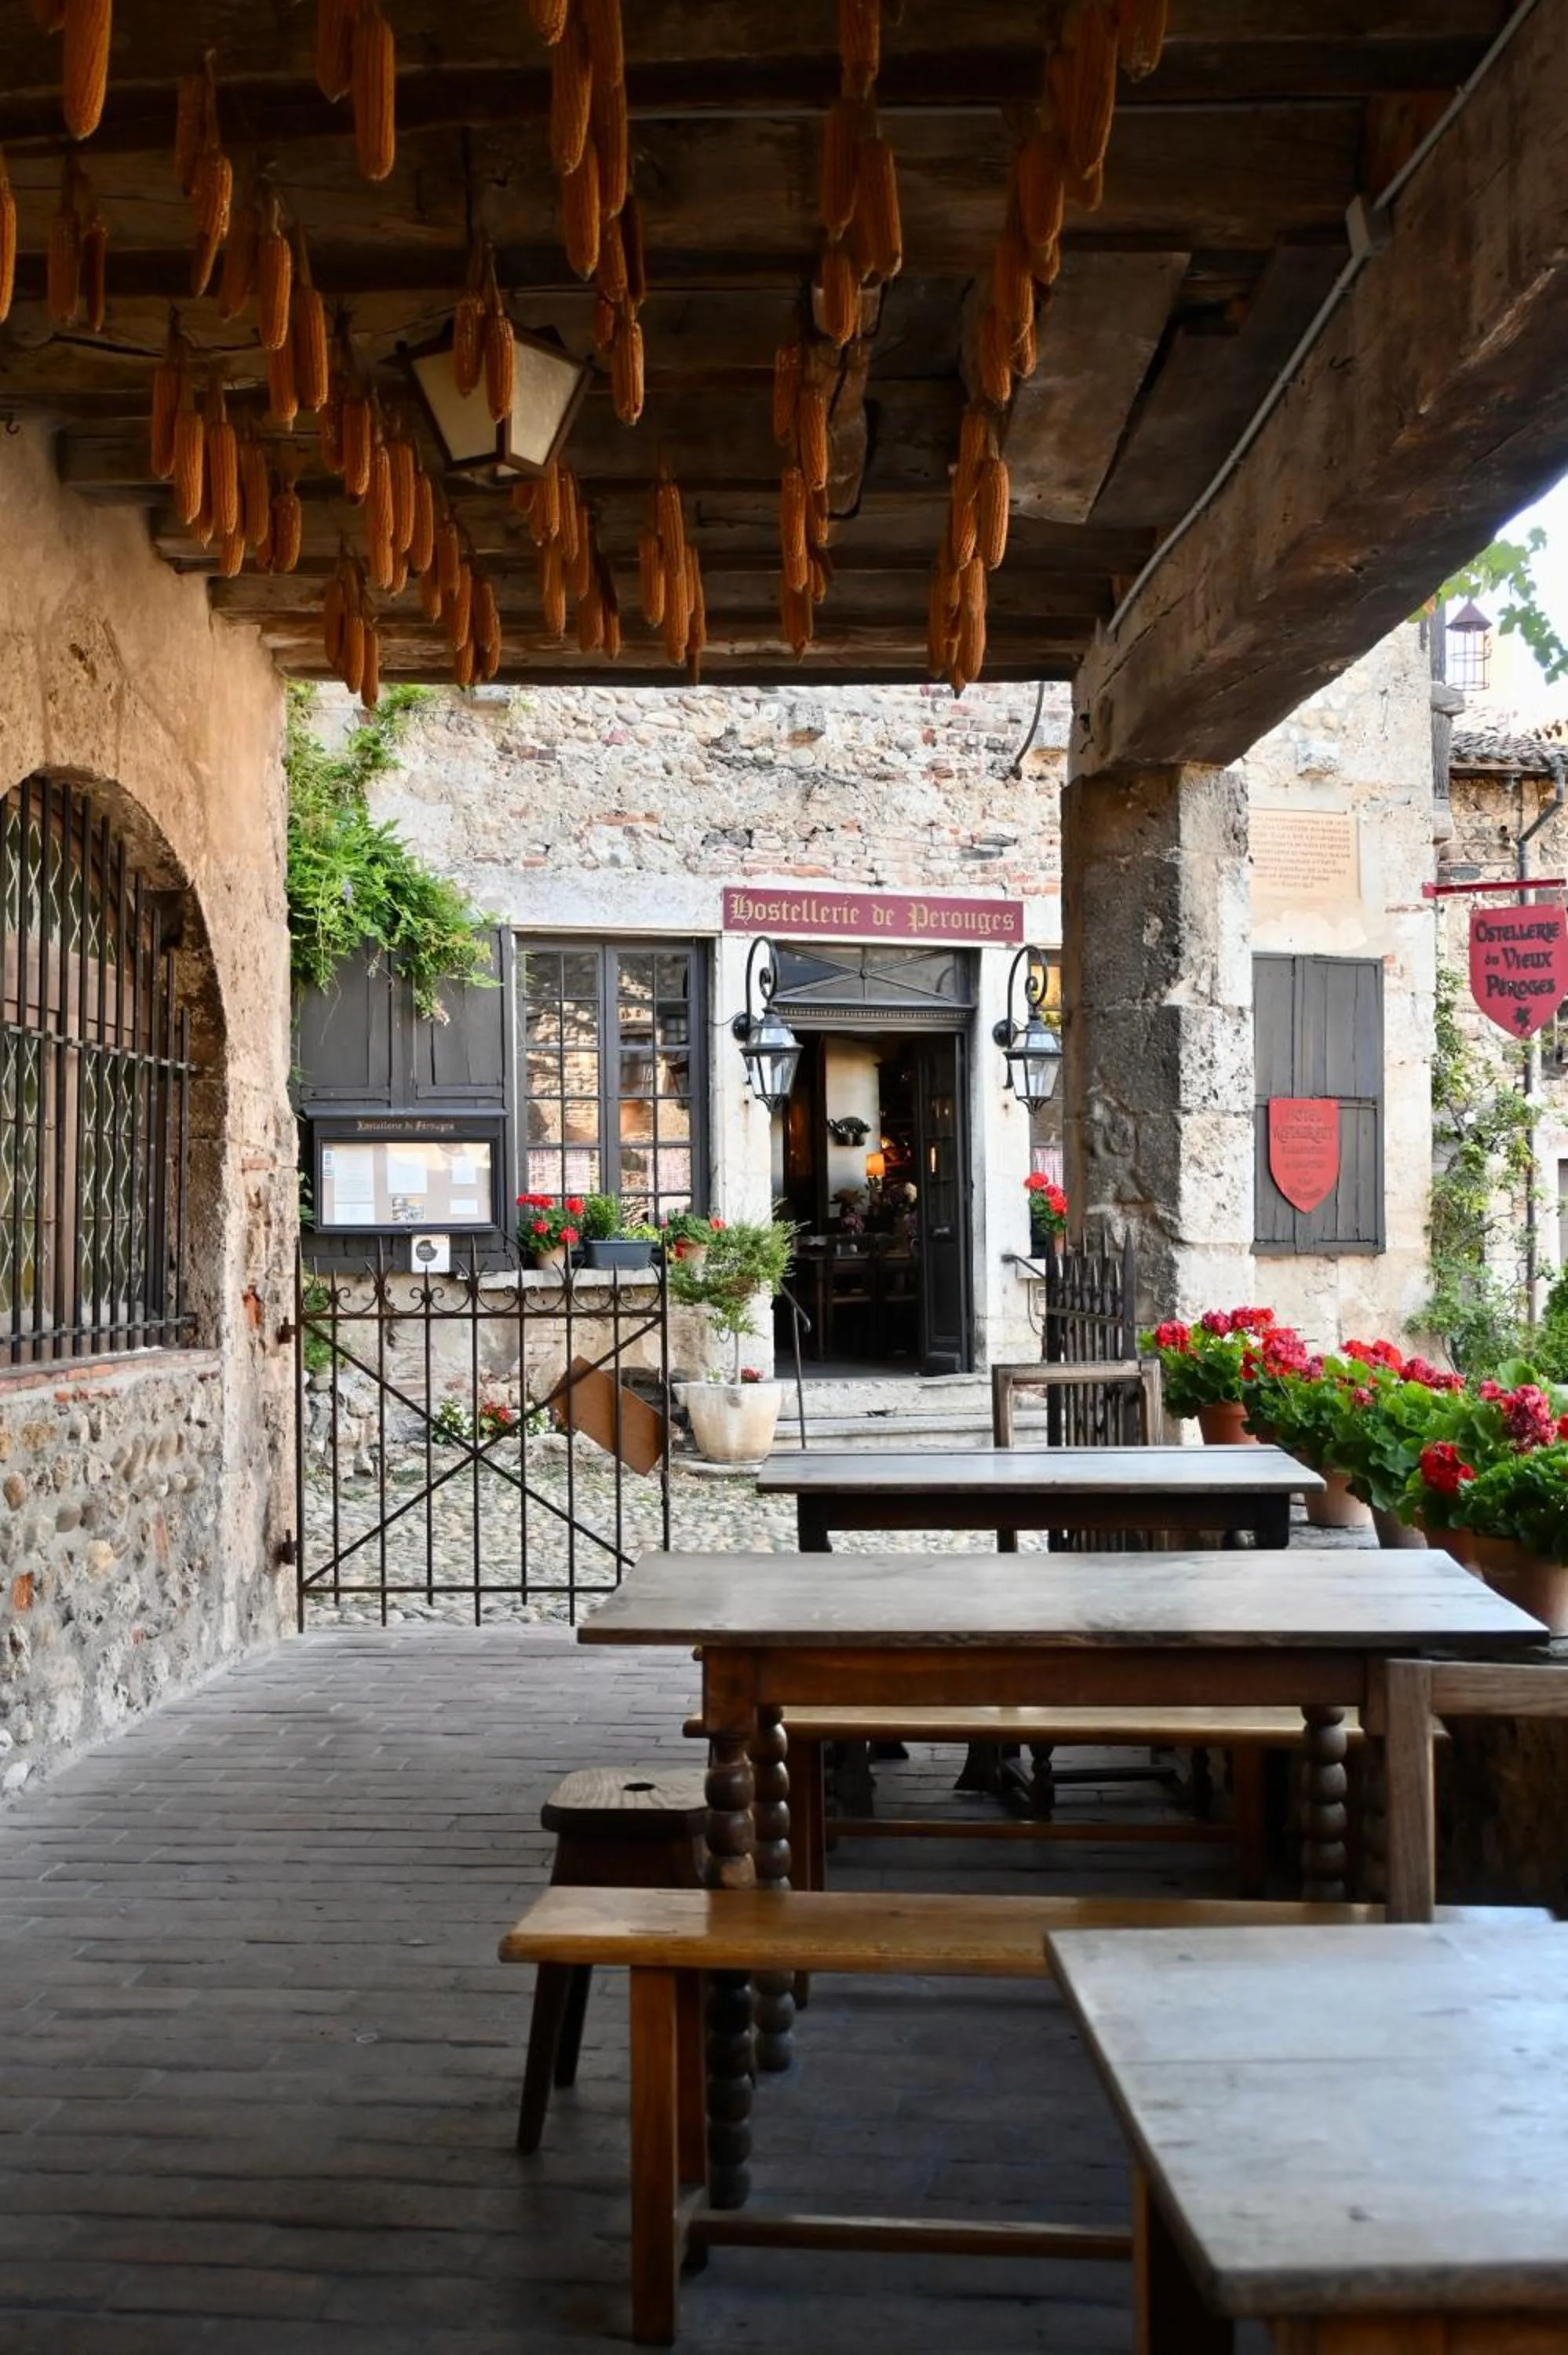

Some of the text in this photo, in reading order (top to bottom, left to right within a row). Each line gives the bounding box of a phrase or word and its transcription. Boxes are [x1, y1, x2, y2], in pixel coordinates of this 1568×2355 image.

[729, 893, 1016, 936] Hostellerie de Perouges
